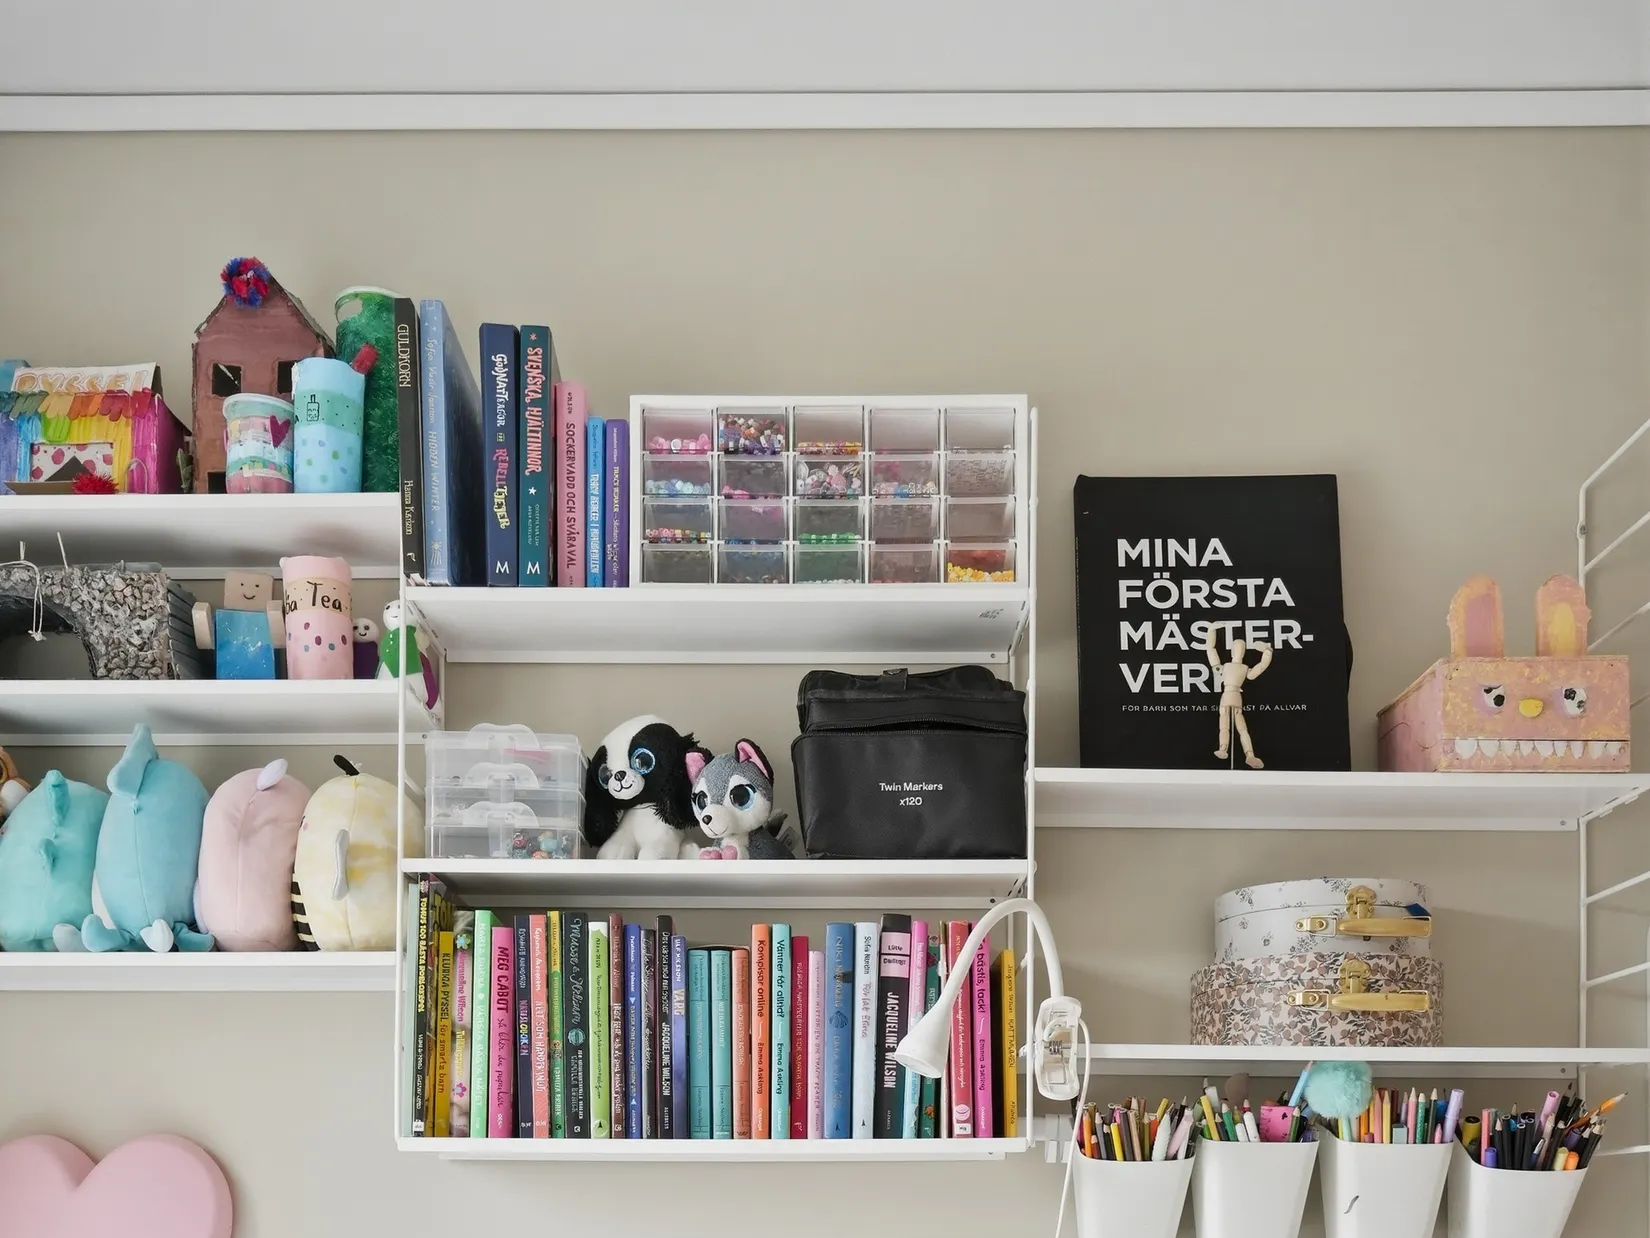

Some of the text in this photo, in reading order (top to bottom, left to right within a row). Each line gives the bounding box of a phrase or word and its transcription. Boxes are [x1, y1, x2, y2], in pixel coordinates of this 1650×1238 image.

[397, 324, 411, 388] GULDKORN
[491, 354, 509, 428] GODNATTSAGOR
[525, 347, 546, 476] SVENSKA HJÄLTINNOR
[566, 422, 576, 489] SOCKERVADD
[428, 431, 441, 512] HIDDEN WINTER
[566, 492, 576, 513] OCH
[566, 516, 580, 548] SVÅRA
[566, 549, 576, 569] VAL
[1117, 538, 1233, 567] MINA
[306, 580, 342, 612] Tea
[1118, 572, 1296, 609] FÖRSTA
[1119, 613, 1314, 651] MÄSTER-
[1122, 704, 1140, 712] FÖR
[1142, 704, 1167, 712] BARN
[1169, 704, 1189, 712] SOM
[1191, 704, 1208, 712] TAR
[879, 782, 943, 792] Twin Markers
[899, 796, 922, 807] x120
[419, 925, 427, 939] 100
[570, 918, 582, 966] Musse
[497, 946, 510, 971] MEG
[755, 940, 766, 986] Kompisar
[776, 940, 786, 973] Vänner
[975, 953, 986, 986] bästis,
[496, 975, 509, 1013] CABOT
[776, 975, 786, 988] för
[440, 990, 450, 1022] PYSSEL
[673, 988, 686, 1016] VARG
[757, 987, 766, 1018] online
[776, 990, 786, 1018] alltid?
[977, 988, 986, 1013] tack!
[536, 1022, 545, 1038] SOM
[883, 992, 900, 1088] JACQUELINE WILSON
[438, 1039, 447, 1070] smarta
[662, 1022, 671, 1096] JACQUELINE WILSON
[438, 1073, 447, 1094] barn
[775, 1067, 784, 1095] Askling
